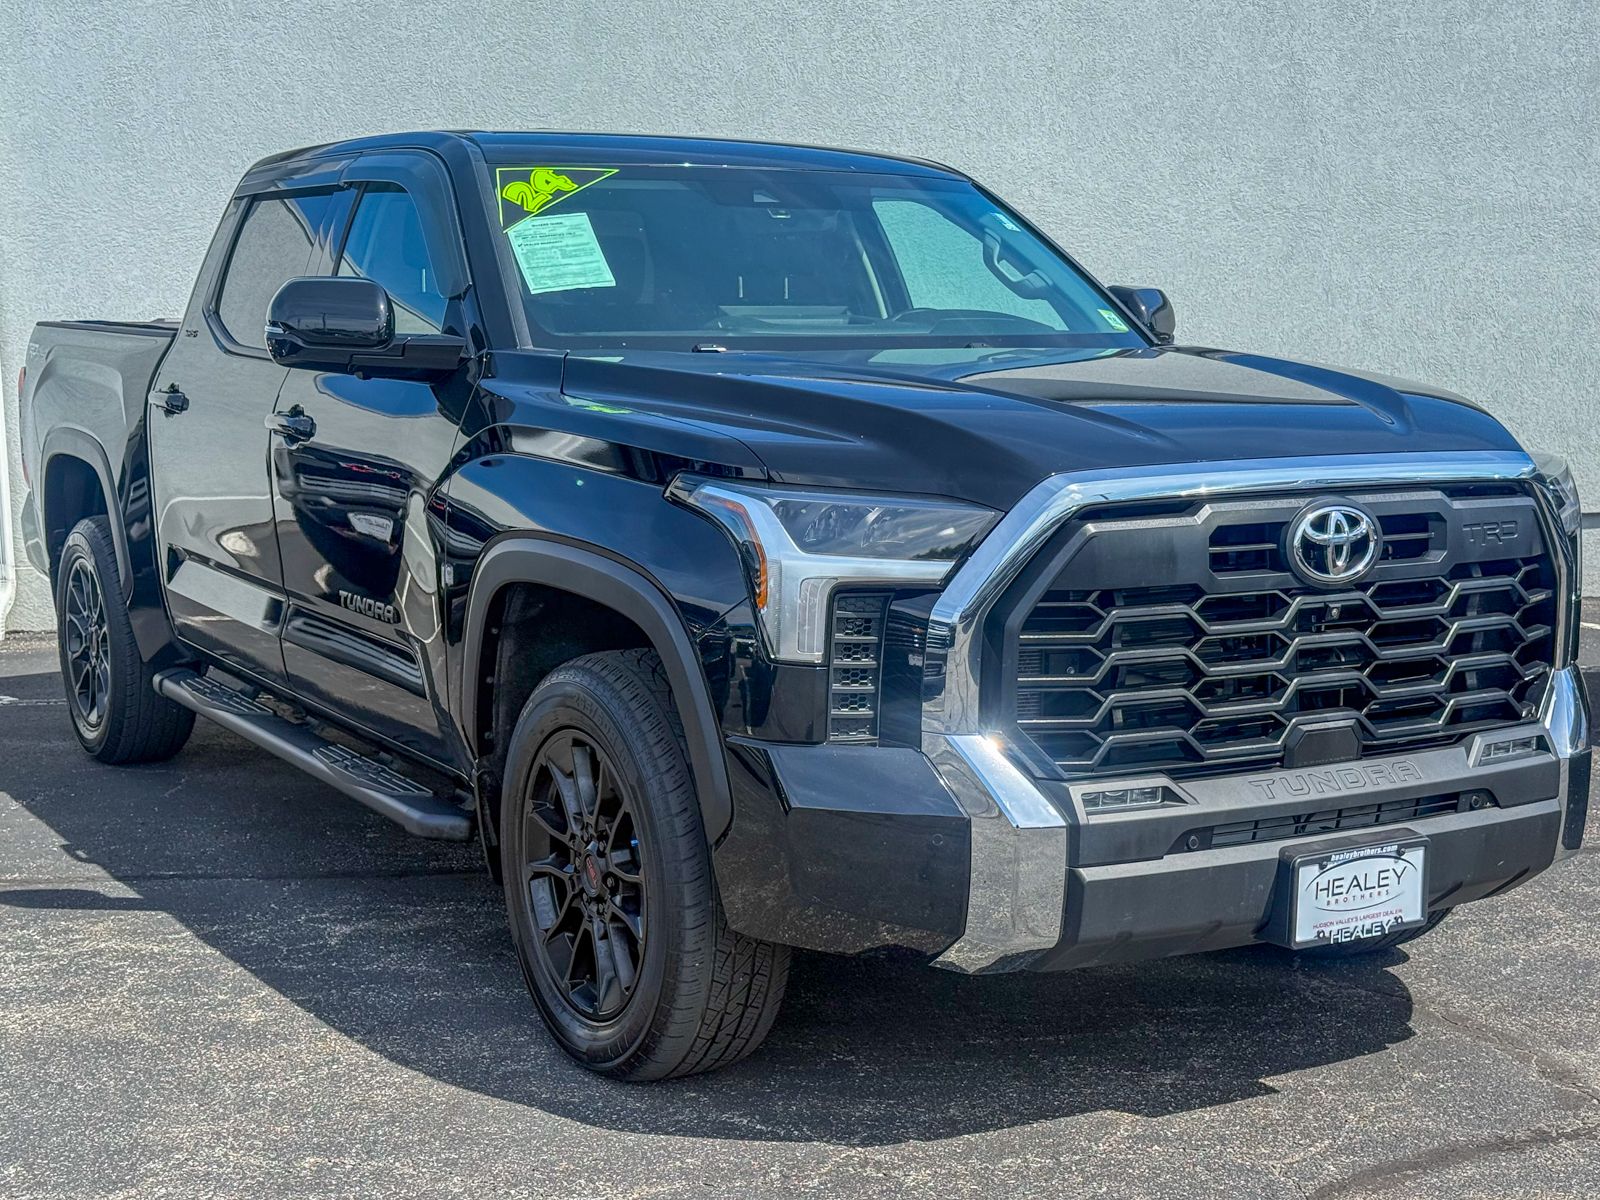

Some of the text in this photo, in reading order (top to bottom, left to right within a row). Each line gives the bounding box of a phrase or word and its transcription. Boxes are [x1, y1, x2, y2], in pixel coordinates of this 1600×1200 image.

[502, 167, 579, 213] 24
[1462, 520, 1518, 546] TRD
[338, 589, 394, 624] TUNDRA
[1248, 760, 1422, 799] TUNDRA
[1330, 844, 1398, 861] healeybrothers.com
[1315, 866, 1407, 900] HEALEY
[1326, 889, 1390, 906] BROTHERS
[1312, 921, 1335, 930] HUDSON
[1359, 911, 1382, 920] LARGEST
[1329, 919, 1391, 944] HEALEY
